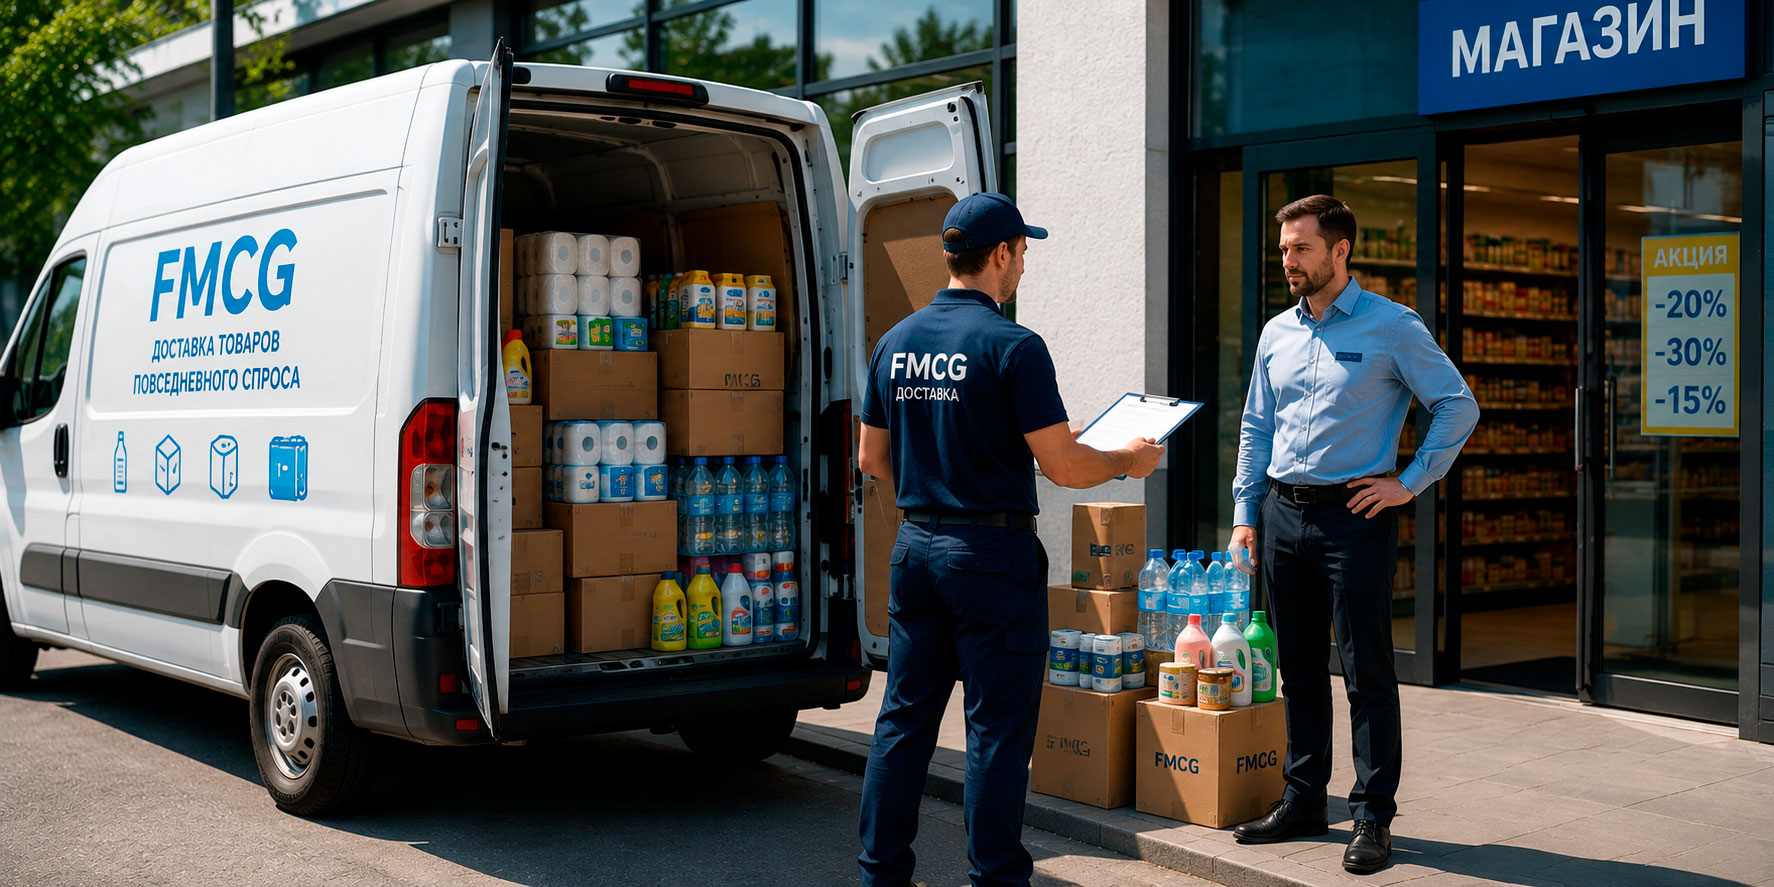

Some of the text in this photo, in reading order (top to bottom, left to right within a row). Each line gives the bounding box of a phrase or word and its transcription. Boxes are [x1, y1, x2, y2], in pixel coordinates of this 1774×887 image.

[1451, 0, 1705, 78] МАГАЗИН
[1654, 245, 1728, 270] АКЦИЯ
[149, 228, 298, 322] FMCG
[1654, 289, 1728, 319] -20%
[151, 329, 281, 363] ДОСТАВКА ТОВАРОВ
[1654, 336, 1728, 366] -30%
[132, 365, 301, 396] ПОВСЕДНЕВНОГО СПРОСА
[890, 352, 968, 381] FMCG
[895, 386, 960, 402] ДОСТАВКА
[1654, 384, 1728, 415] -15%
[1154, 751, 1199, 774] FMCG
[1236, 749, 1278, 773] FMCG
